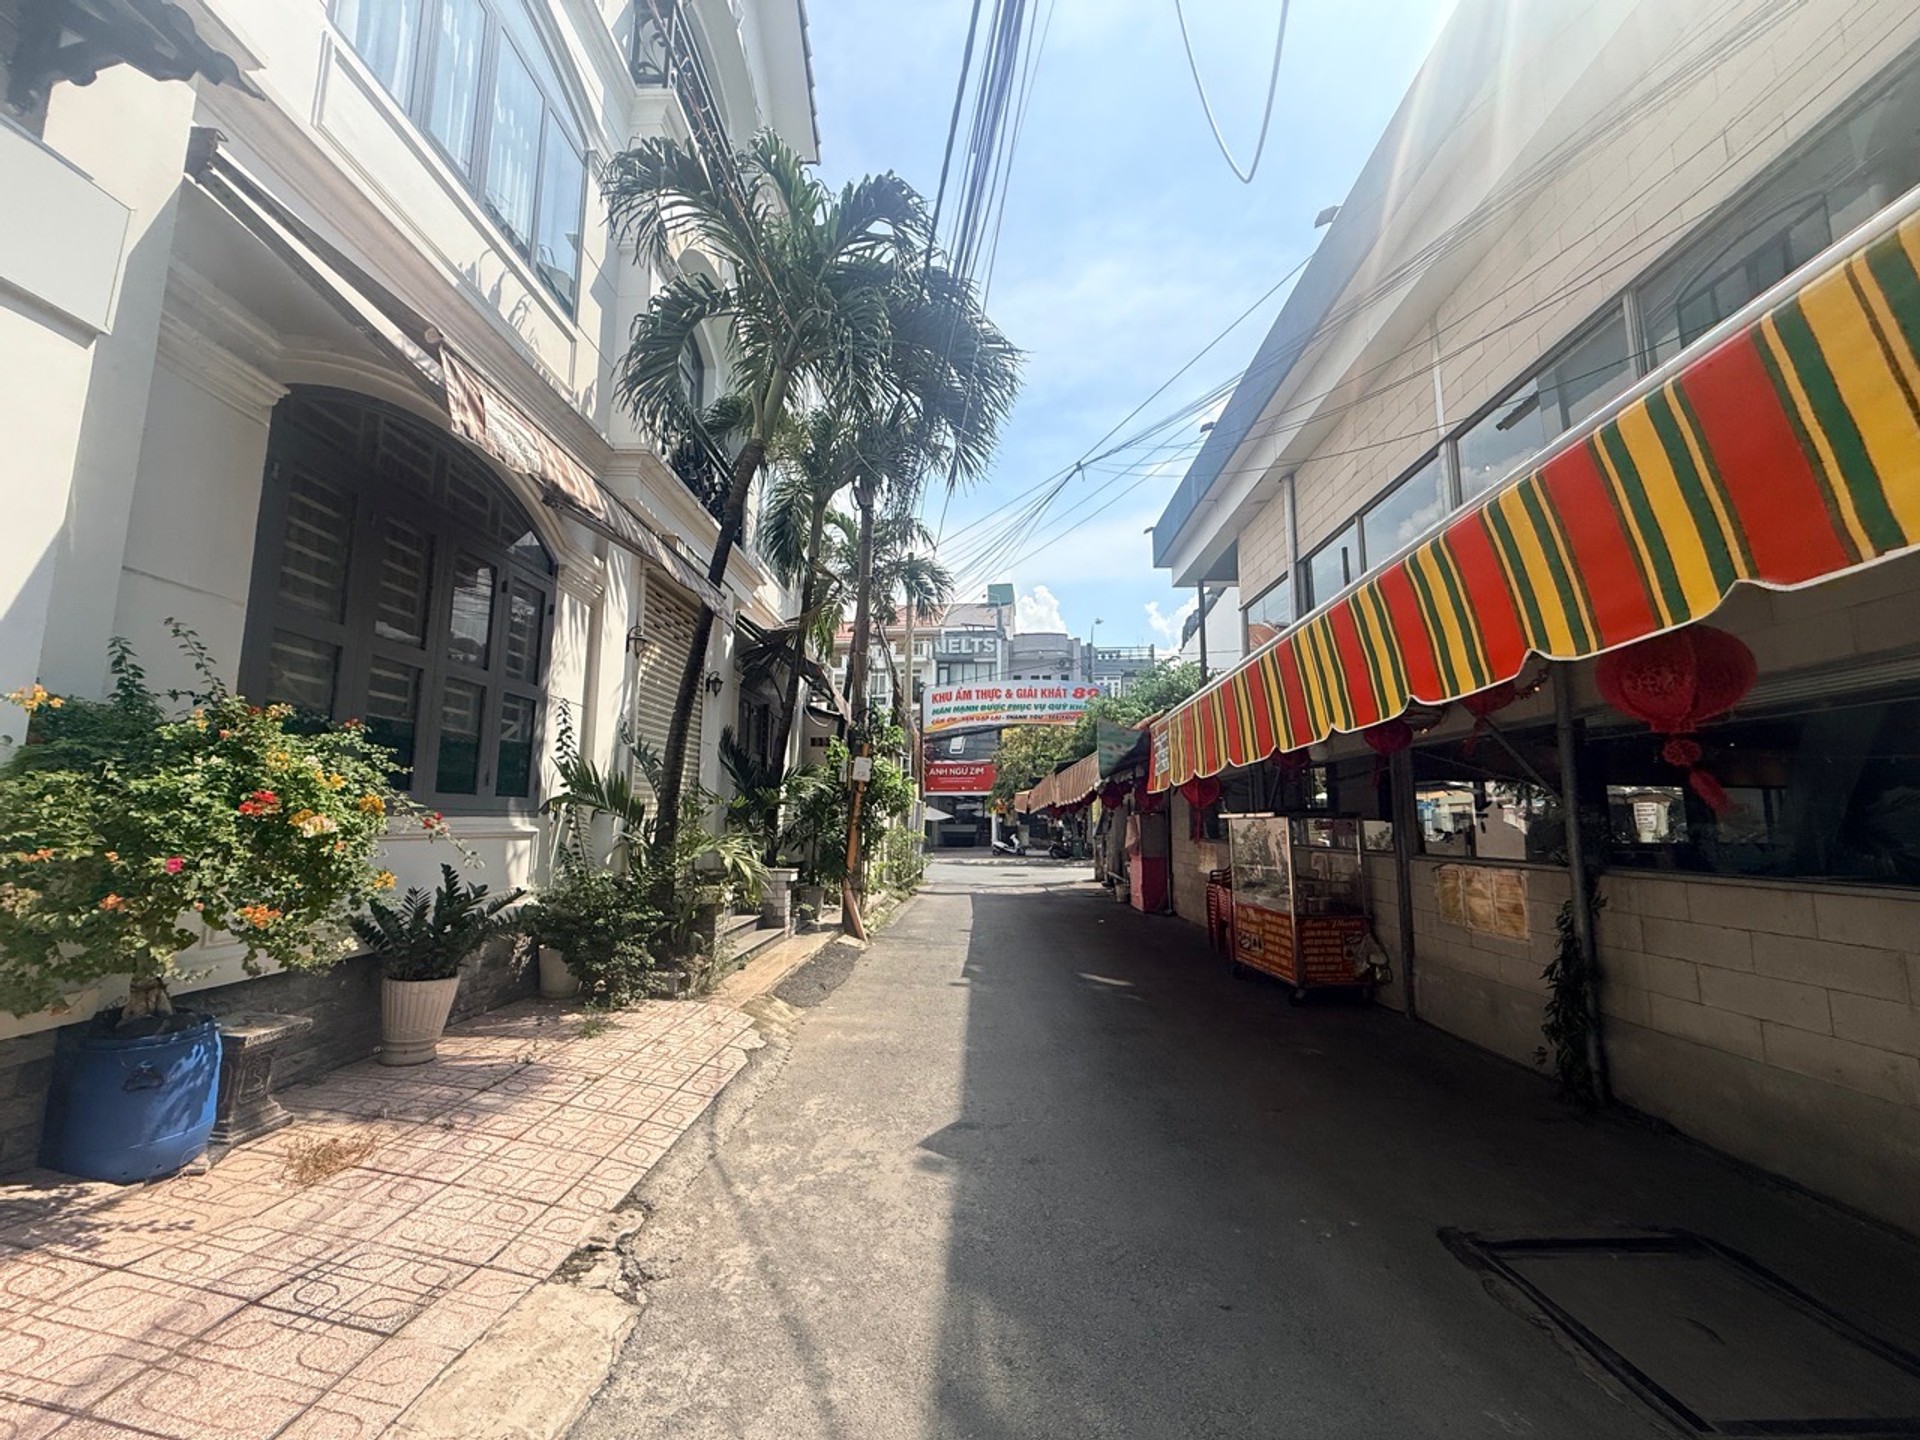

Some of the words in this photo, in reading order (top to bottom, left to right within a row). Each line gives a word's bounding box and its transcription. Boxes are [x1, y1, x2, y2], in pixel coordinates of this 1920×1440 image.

[931, 691, 953, 704] KHU
[975, 687, 1002, 702] THỰC
[1004, 688, 1013, 699] &
[1016, 685, 1038, 699] GIẢI
[1041, 685, 1068, 699] KHÁT
[1007, 703, 1032, 712] PHỤC
[1034, 703, 1047, 712] VỤ
[928, 767, 948, 776] ANH
[949, 765, 968, 776] NGỮ
[969, 767, 984, 775] ZIM
